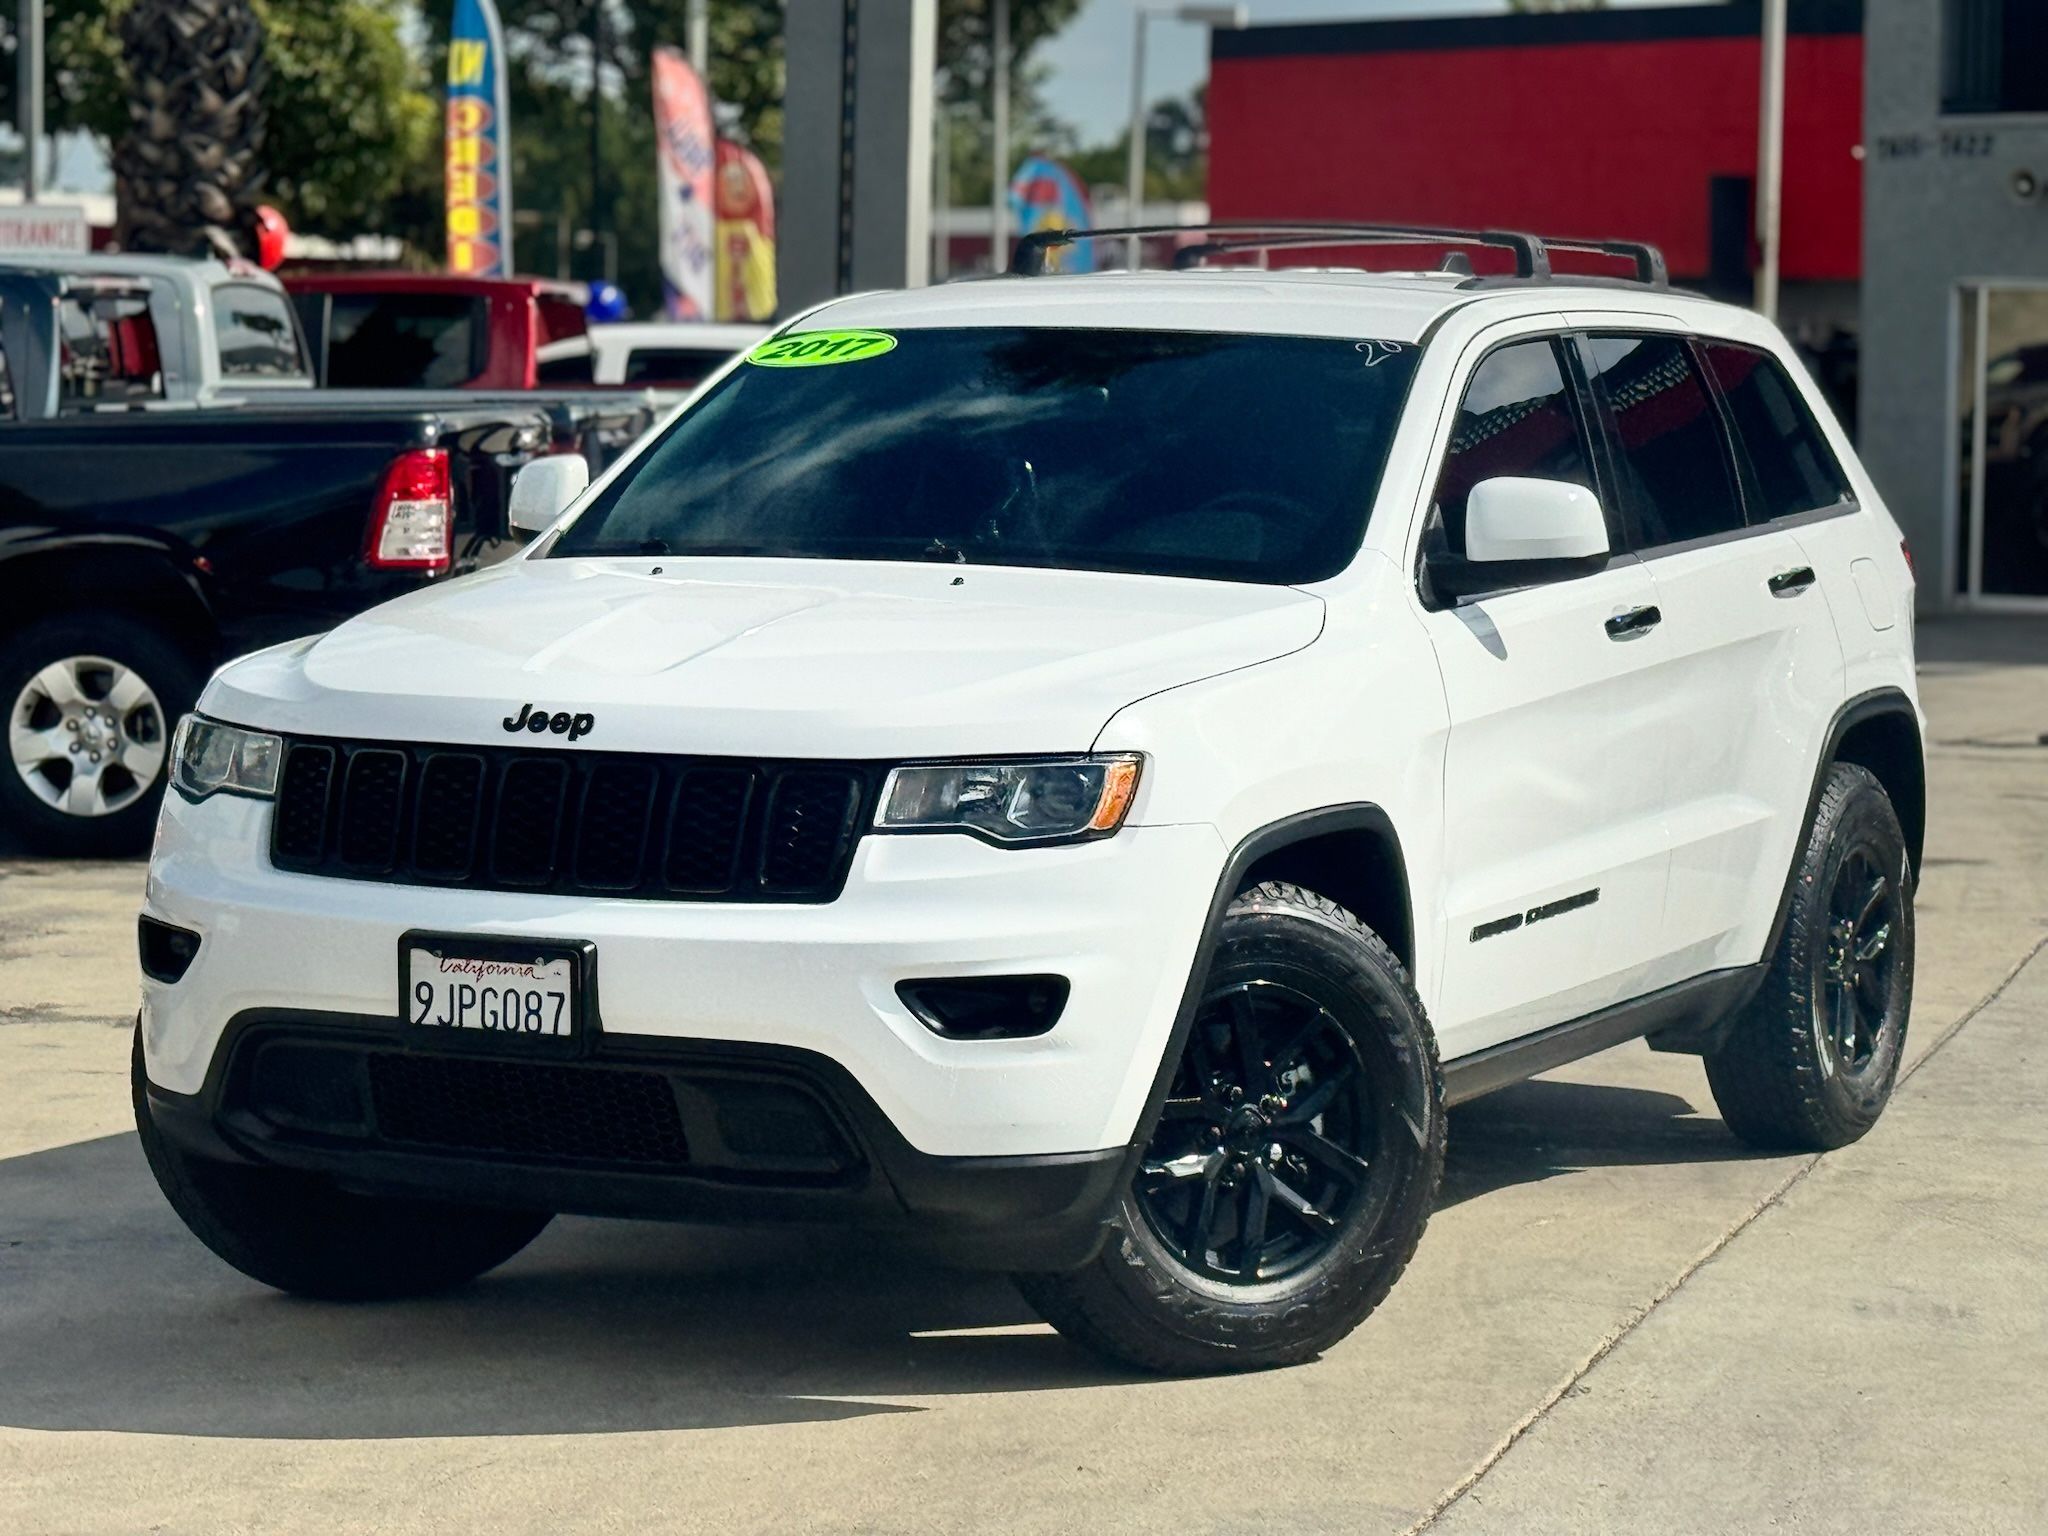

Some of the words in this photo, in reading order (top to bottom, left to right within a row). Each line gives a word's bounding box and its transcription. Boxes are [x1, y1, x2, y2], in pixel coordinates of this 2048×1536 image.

[757, 338, 886, 361] 2017
[502, 703, 595, 742] Jeep
[439, 958, 546, 983] California
[415, 981, 566, 1037] 9JPG087
